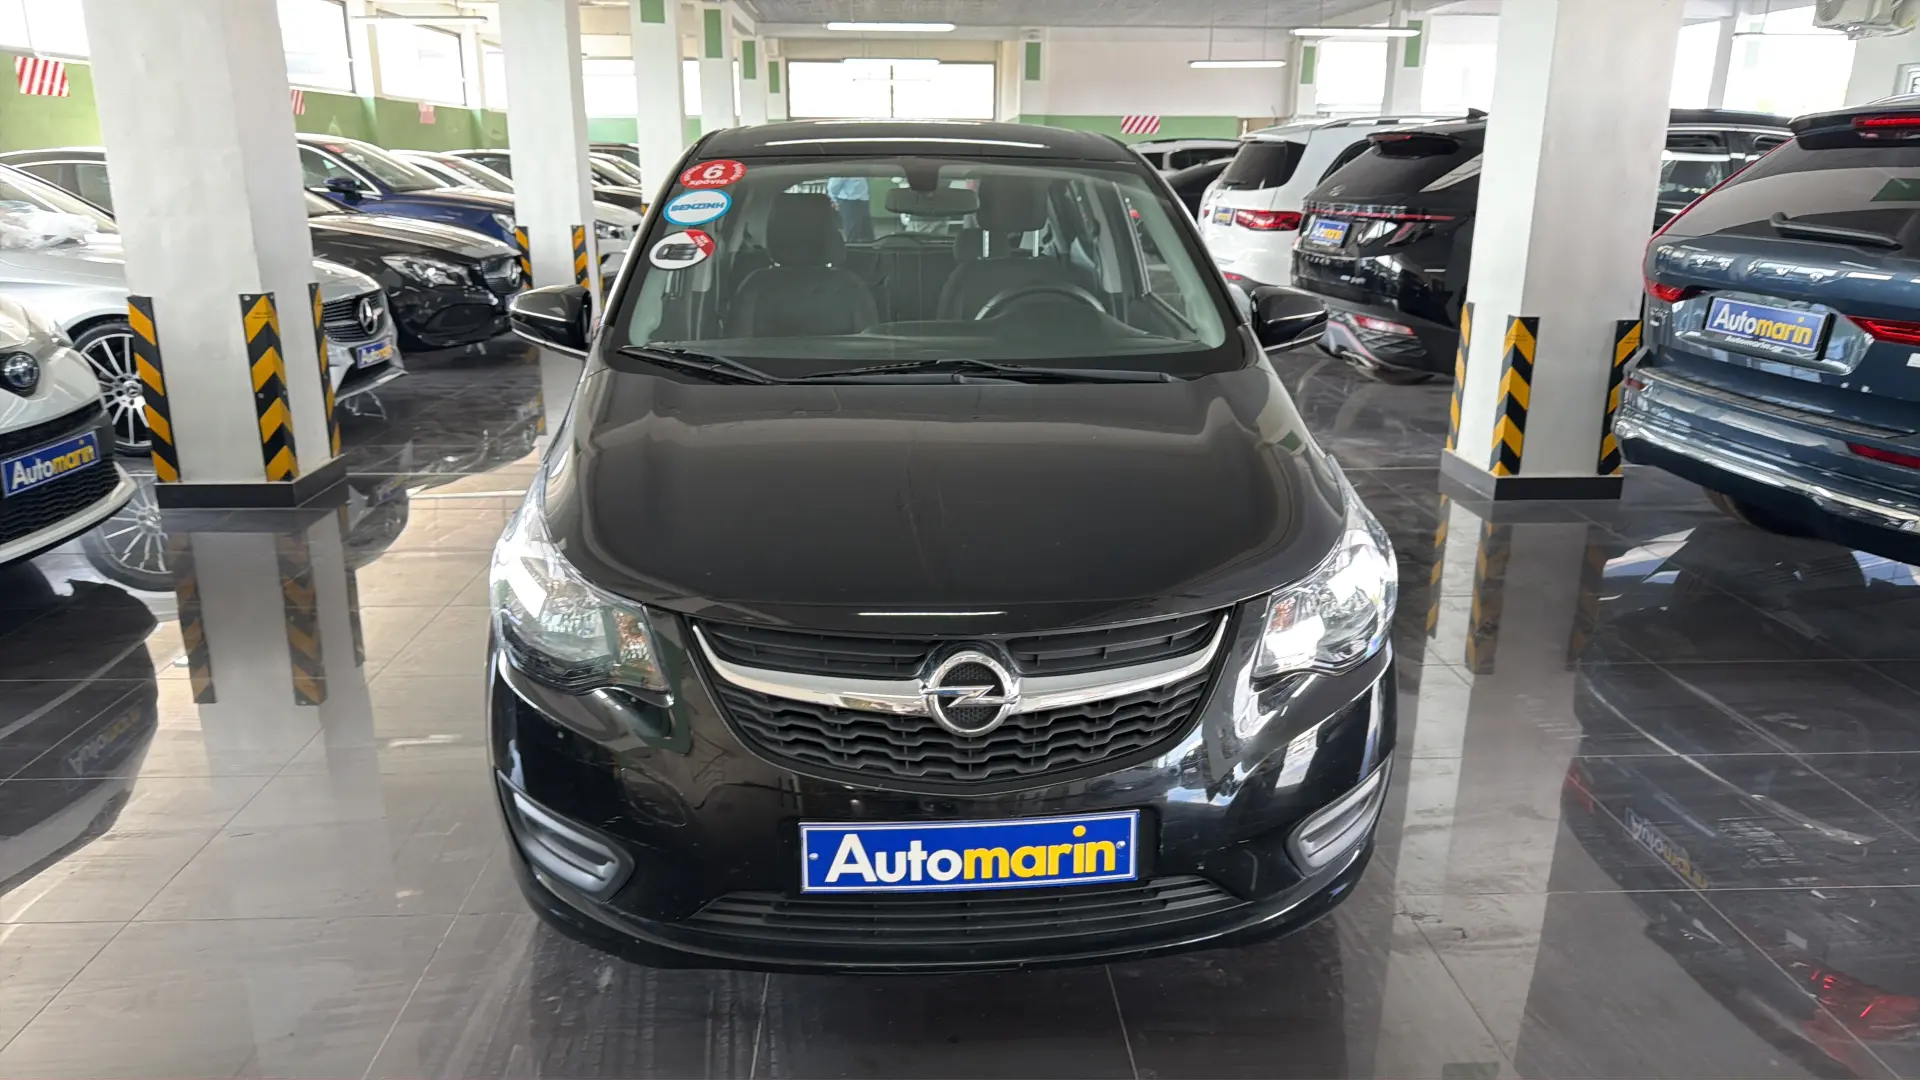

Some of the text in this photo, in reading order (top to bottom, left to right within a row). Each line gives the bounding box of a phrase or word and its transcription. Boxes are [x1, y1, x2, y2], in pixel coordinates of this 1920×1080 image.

[702, 165, 726, 179] 6
[1711, 303, 1813, 345] Automarin
[11, 439, 95, 489] Automarin
[824, 825, 1116, 883] Automarin
